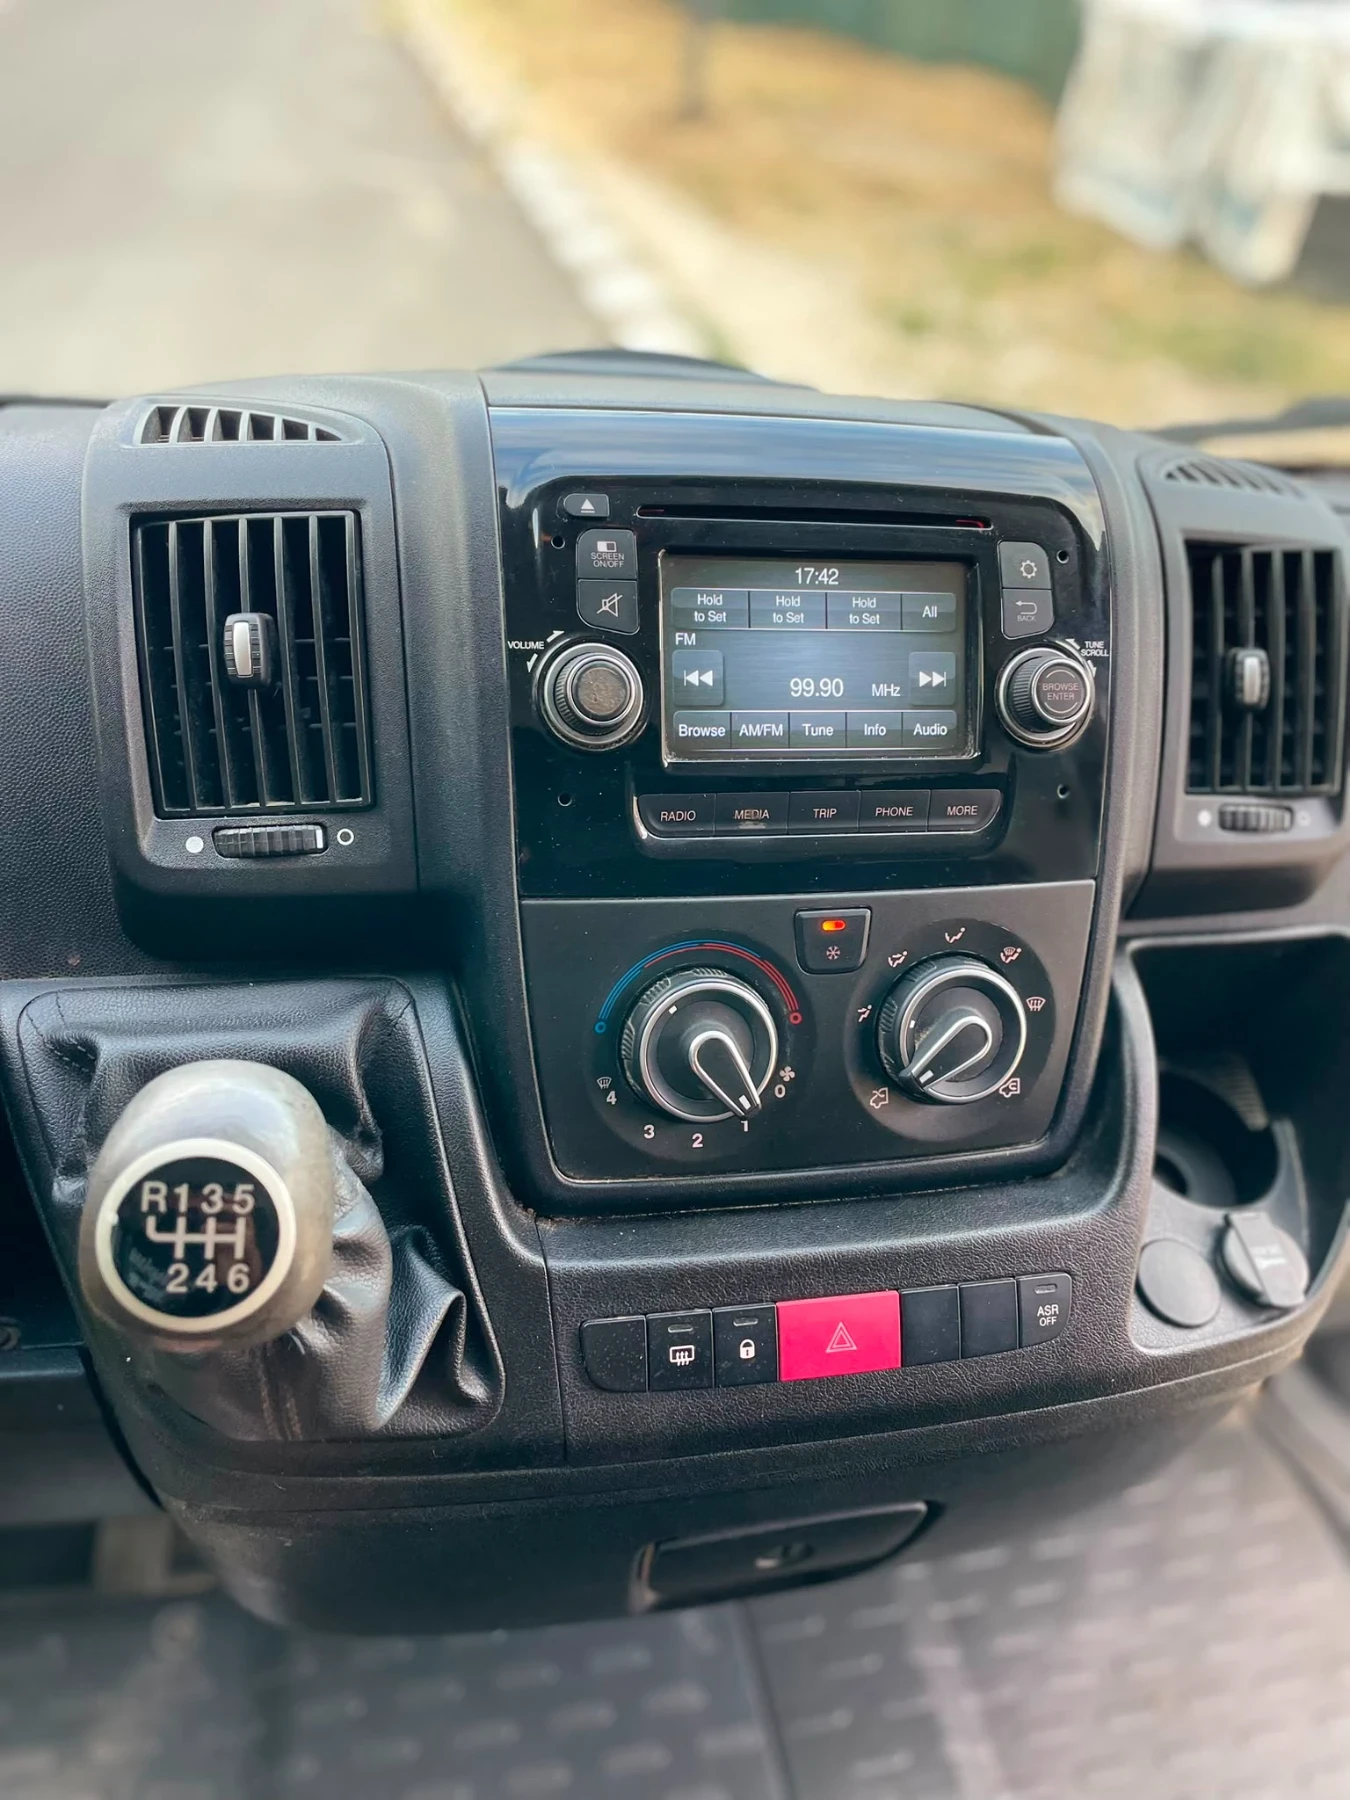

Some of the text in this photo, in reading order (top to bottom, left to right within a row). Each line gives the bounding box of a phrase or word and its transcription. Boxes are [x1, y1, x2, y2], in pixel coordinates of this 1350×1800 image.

[590, 552, 625, 560] SCREEN
[593, 560, 624, 568] ON/OFF
[795, 568, 839, 585] 17:42
[697, 594, 723, 606] Hold
[775, 595, 800, 607] Hold
[852, 596, 876, 608] Hold
[694, 611, 727, 623] to Set
[773, 612, 804, 624] to Set
[922, 606, 938, 618] All
[1016, 614, 1037, 622] BACK
[849, 613, 880, 625] to Set
[507, 641, 544, 650] VOLUME
[675, 633, 696, 646] FM
[1084, 641, 1104, 649] TUNE
[1080, 648, 1109, 657] SCROLL
[789, 678, 901, 697] 99.90 MHz
[1042, 683, 1079, 691] BROWSE
[1047, 692, 1075, 701] ENTER
[678, 724, 726, 738] Browse
[739, 724, 783, 737] AM/FM
[802, 723, 834, 736] Tune
[864, 723, 887, 737] Info
[913, 723, 948, 736] Audio
[660, 810, 696, 822] RADIO
[733, 809, 770, 820] MEDIA
[812, 808, 837, 819] TRIP
[875, 806, 913, 817] PHONE
[946, 805, 978, 816] MORE
[774, 1083, 786, 1098] 0
[606, 1090, 617, 1105] 4
[643, 1124, 655, 1139] 3
[692, 1132, 704, 1148] 2
[141, 1181, 256, 1214] R 1 3 5
[166, 1262, 250, 1293] 2 4 6
[1036, 1304, 1059, 1316] ASR
[1039, 1316, 1057, 1326] OFF
